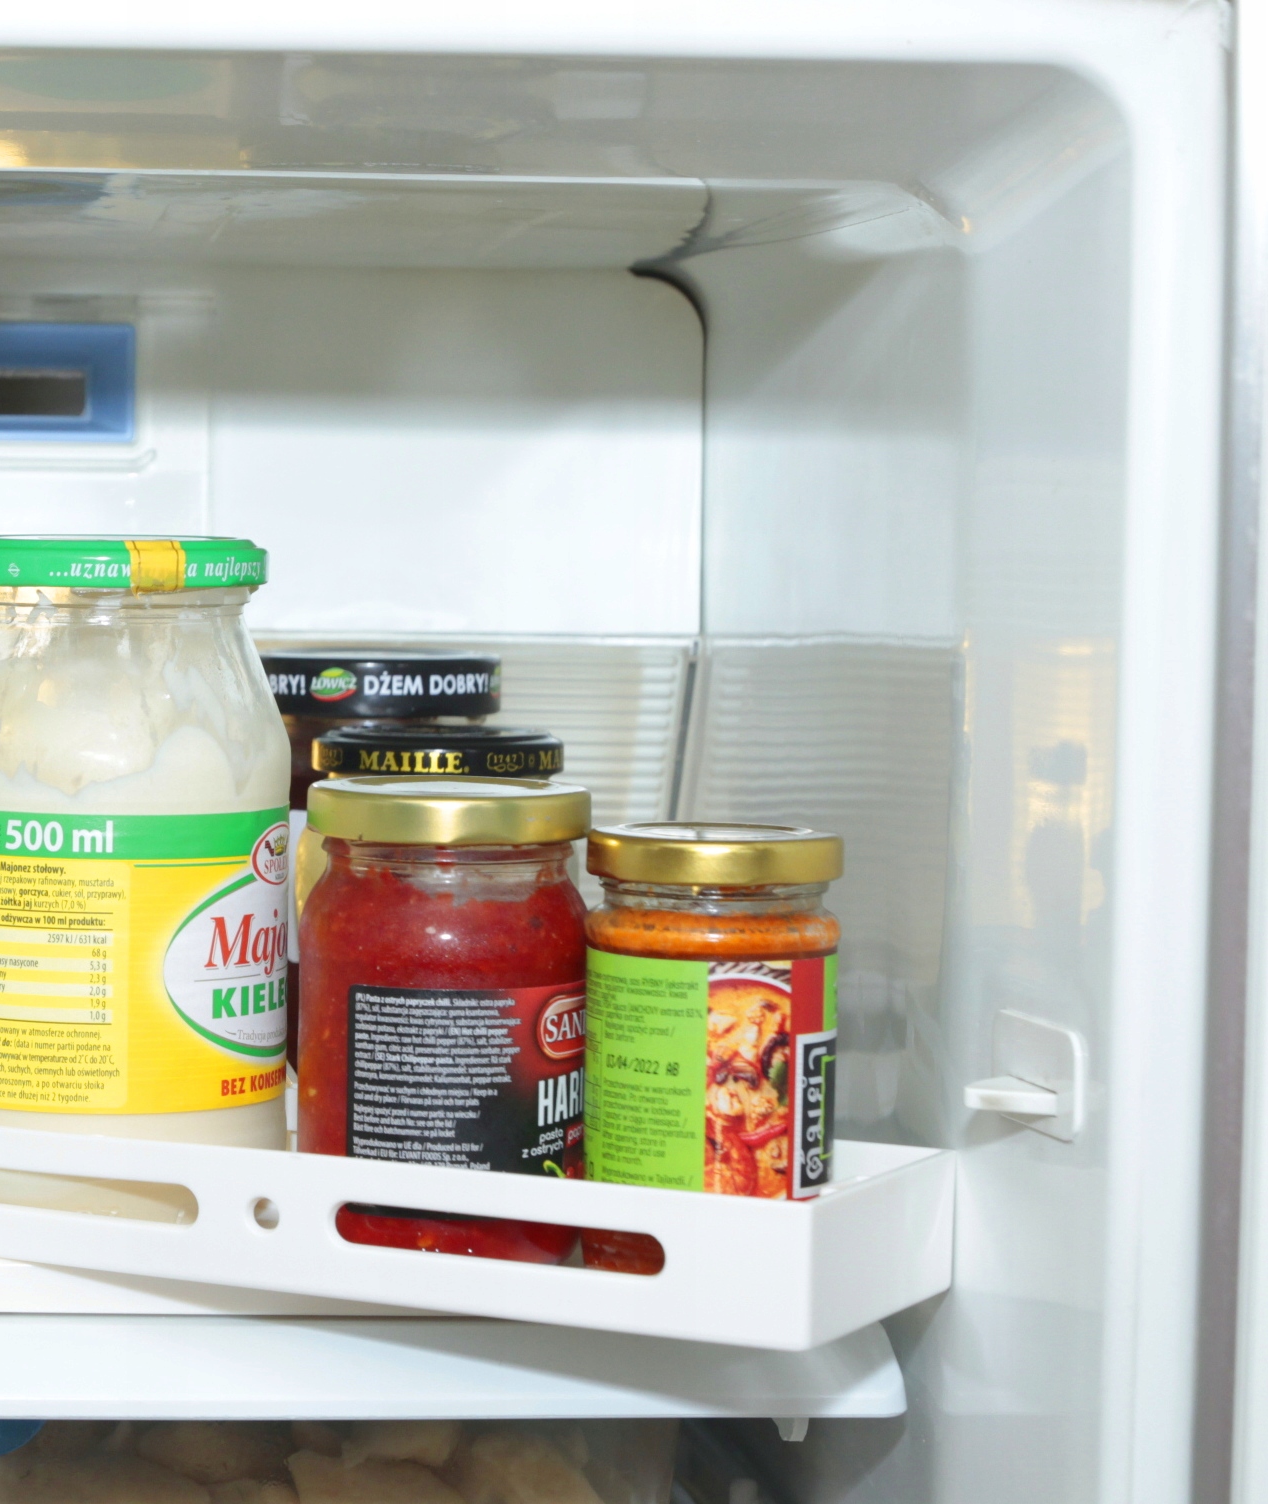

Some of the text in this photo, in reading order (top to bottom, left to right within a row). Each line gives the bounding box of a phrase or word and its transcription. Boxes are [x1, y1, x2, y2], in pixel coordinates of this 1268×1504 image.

[49, 556, 262, 582] ...uznaw najlepszy
[270, 673, 307, 696] BRY!
[363, 670, 424, 697] DŻEM
[429, 673, 489, 696] DOBRY!
[5, 819, 64, 852] 500
[72, 820, 114, 853] ml
[0, 861, 67, 876] Majonez stołowy.
[3, 875, 37, 887] rzepakowy
[38, 877, 77, 887] rafinowany,
[78, 879, 115, 888] musztarda
[19, 889, 51, 898] gorczyca,
[52, 890, 73, 899] cukier,
[74, 890, 87, 899] sól,
[1, 897, 22, 907] żółtka
[22, 899, 33, 910] jaj
[34, 899, 60, 910] kurzych
[1, 914, 33, 926] odżywcza
[43, 915, 57, 925] 100
[57, 916, 67, 926] ml
[68, 917, 106, 929] produktu:
[47, 934, 65, 944] 2597
[78, 935, 91, 945] 631
[92, 935, 107, 945] kcal
[92, 949, 102, 958] 68
[9, 959, 39, 970] nasycone
[90, 961, 101, 971] 5,3
[90, 973, 101, 984] 2,3
[89, 986, 101, 996] 2,0
[90, 998, 100, 1008] 1,9
[212, 977, 287, 1020] KIELE
[90, 1010, 99, 1020] 1,0
[29, 1028, 65, 1038] atmosferze
[66, 1030, 102, 1041] ochronnej.
[2, 1038, 12, 1047] do:
[13, 1038, 30, 1049] (data
[34, 1041, 56, 1049] numer
[57, 1040, 75, 1052] partii
[76, 1040, 102, 1052] podane
[102, 1044, 111, 1052] na
[29, 1054, 69, 1065] temperaturze
[69, 1055, 77, 1064] od
[90, 1055, 98, 1064] do
[7, 1064, 33, 1075] suchych,
[34, 1066, 64, 1077] ciemnych
[65, 1067, 76, 1077] lub
[77, 1067, 120, 1079] oświetlonych
[41, 1080, 50, 1090] po
[51, 1079, 82, 1089] otwarciu
[84, 1079, 105, 1090] słoika
[221, 1076, 246, 1096] BEZ
[7, 1088, 17, 1097] nie
[57, 1092, 91, 1104] tygodnie.
[538, 1127, 564, 1146] pasta
[521, 1140, 564, 1159] z ostrych
